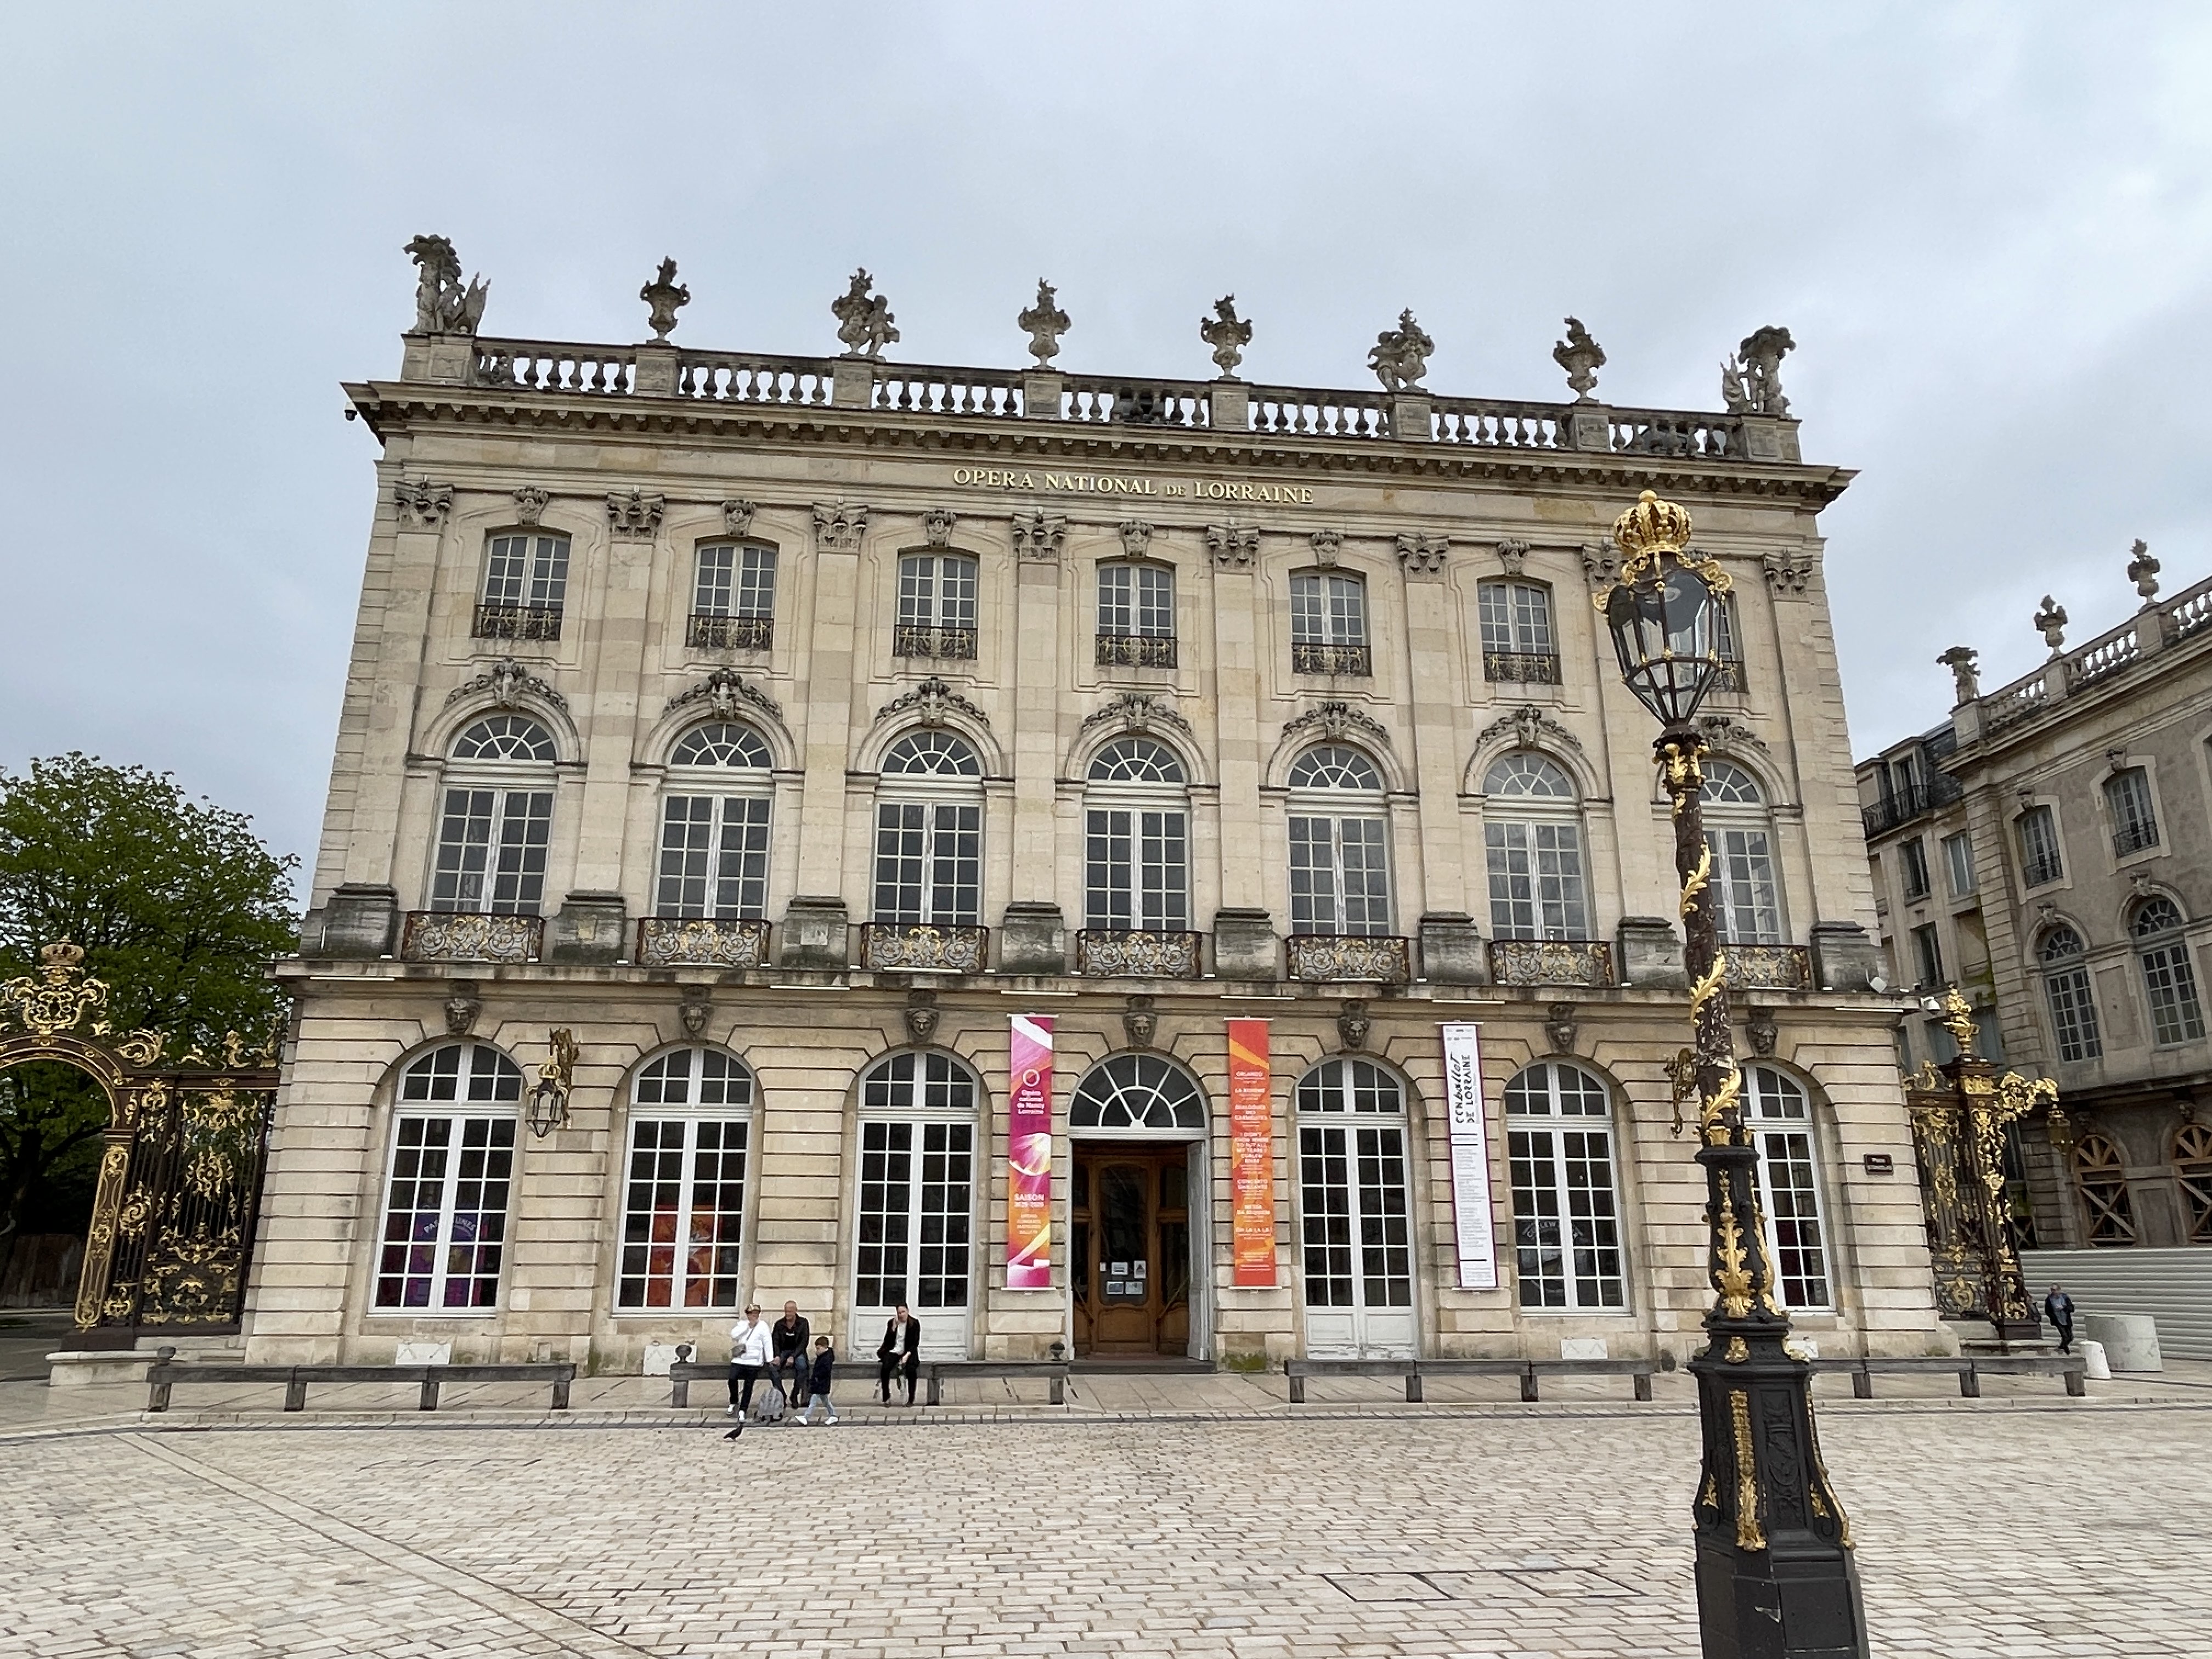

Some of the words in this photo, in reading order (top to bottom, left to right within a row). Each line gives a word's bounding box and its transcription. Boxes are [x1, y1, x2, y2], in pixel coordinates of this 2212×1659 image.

[953, 469, 1035, 489] OPERA
[1045, 473, 1157, 495] NATIONAL
[1166, 485, 1186, 496] DE
[1195, 481, 1313, 504] LORRAINE
[1462, 1054, 1474, 1105] LORRAINE
[1466, 1110, 1475, 1124] DE
